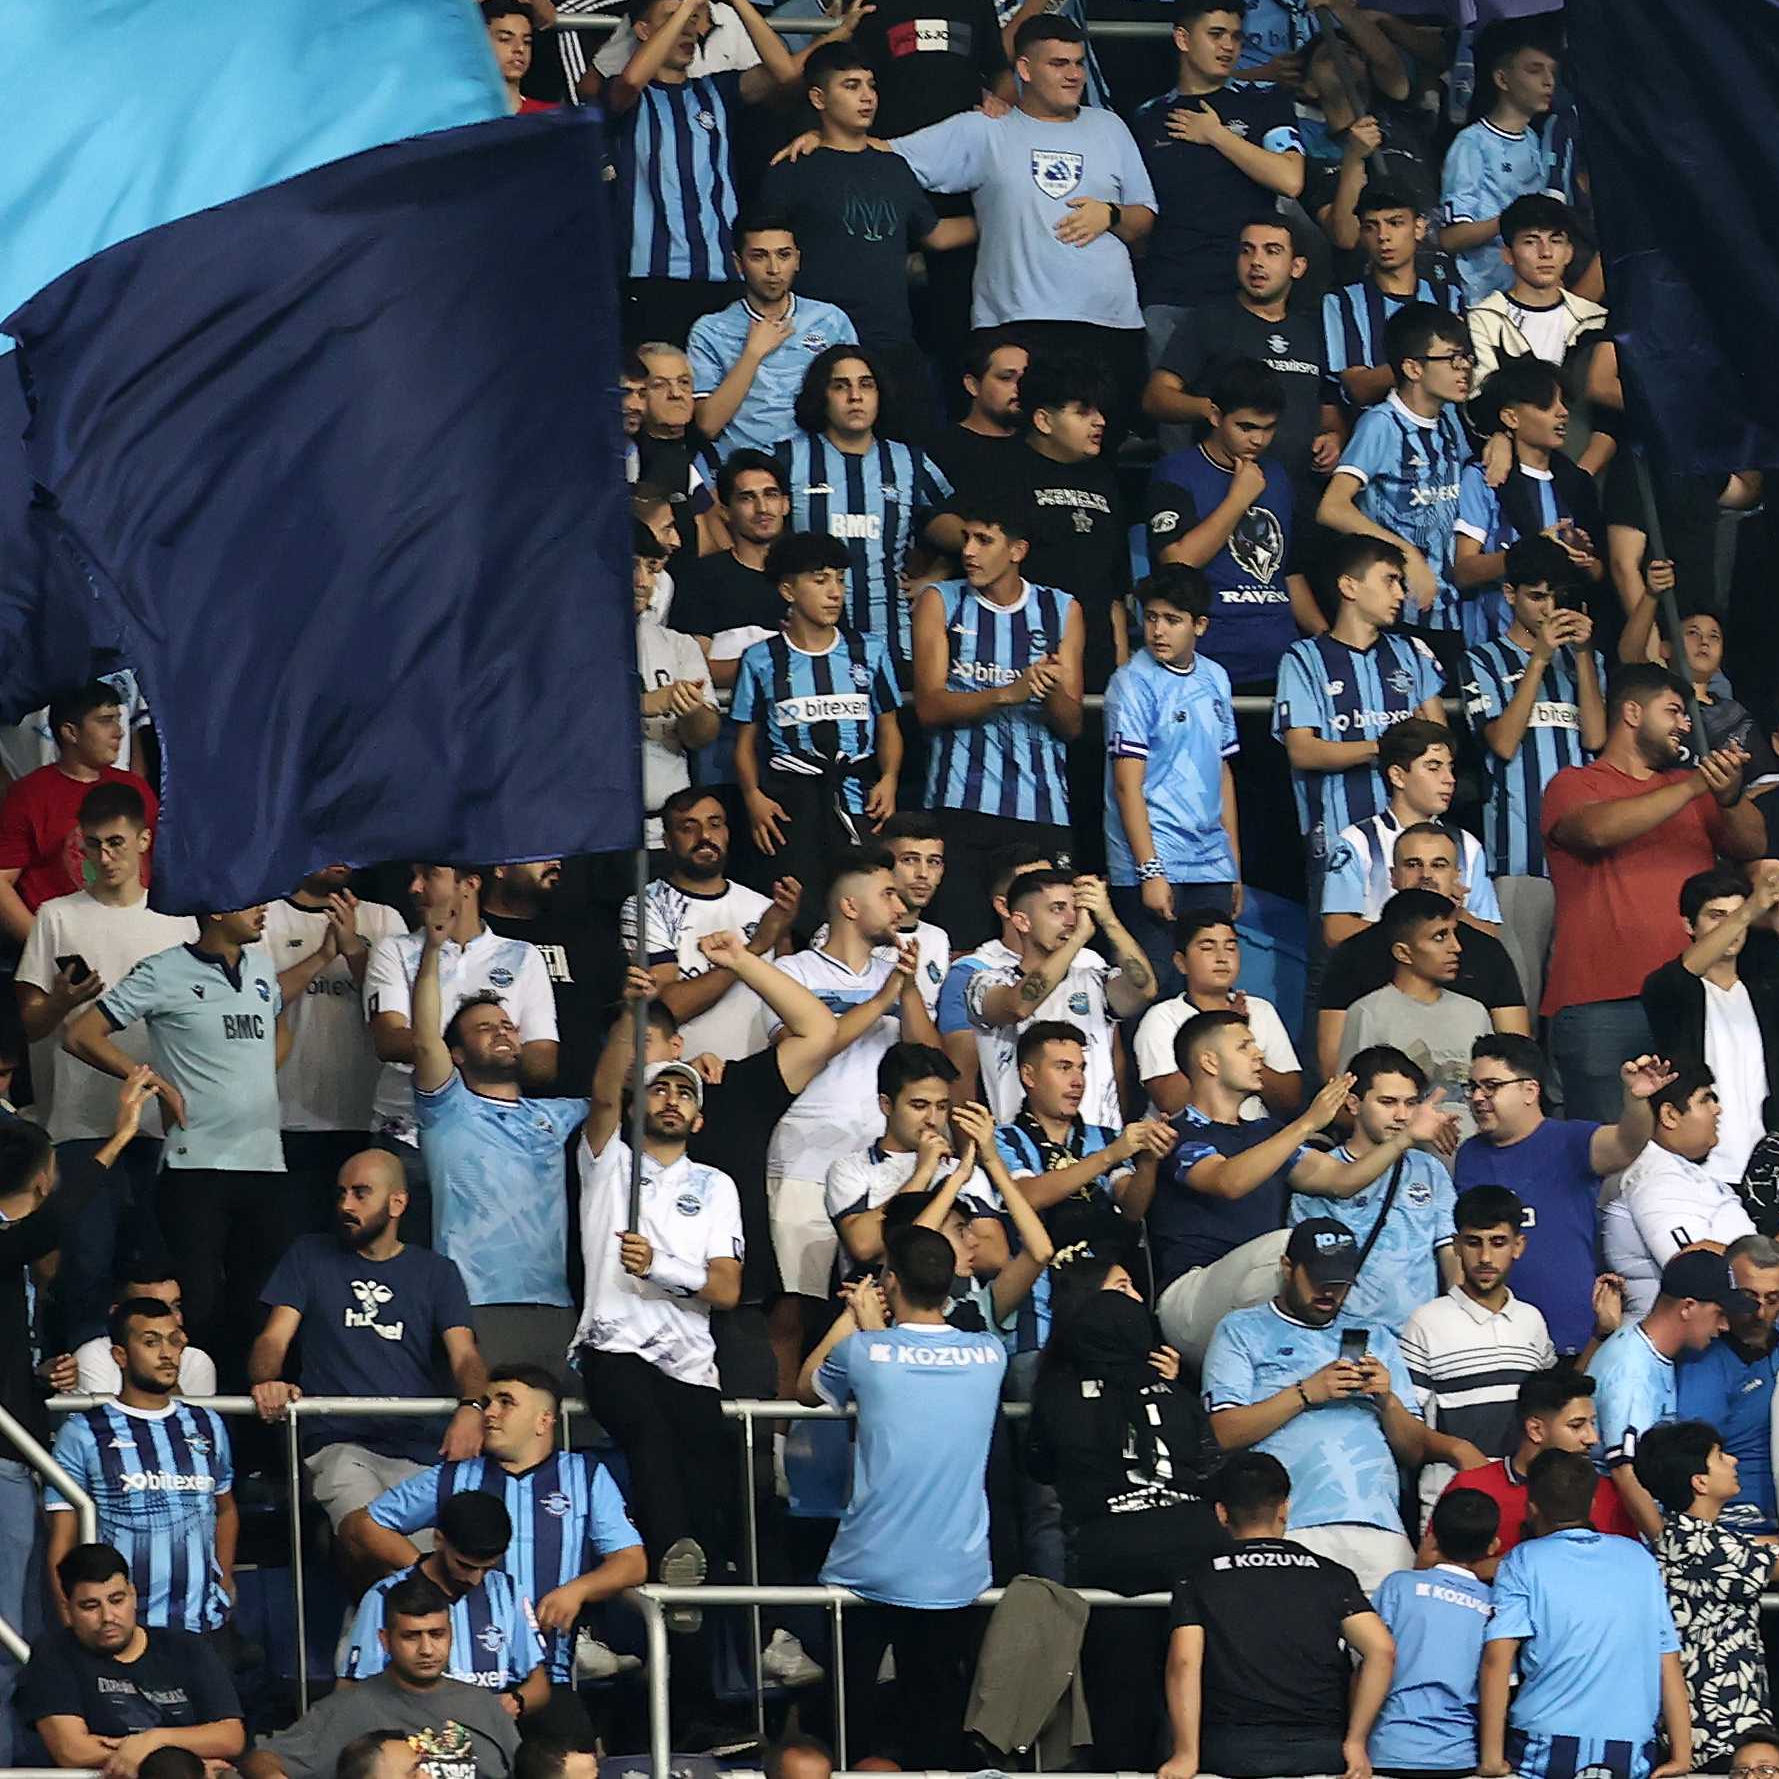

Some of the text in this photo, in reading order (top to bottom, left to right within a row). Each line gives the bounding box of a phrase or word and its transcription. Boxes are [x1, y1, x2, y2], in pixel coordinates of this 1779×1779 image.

[831, 513, 882, 541] BMC
[222, 1013, 265, 1041] BMC
[897, 1346, 999, 1366] KOZUVA
[147, 1470, 216, 1494] bitexen
[1233, 1553, 1321, 1570] KOZUVA
